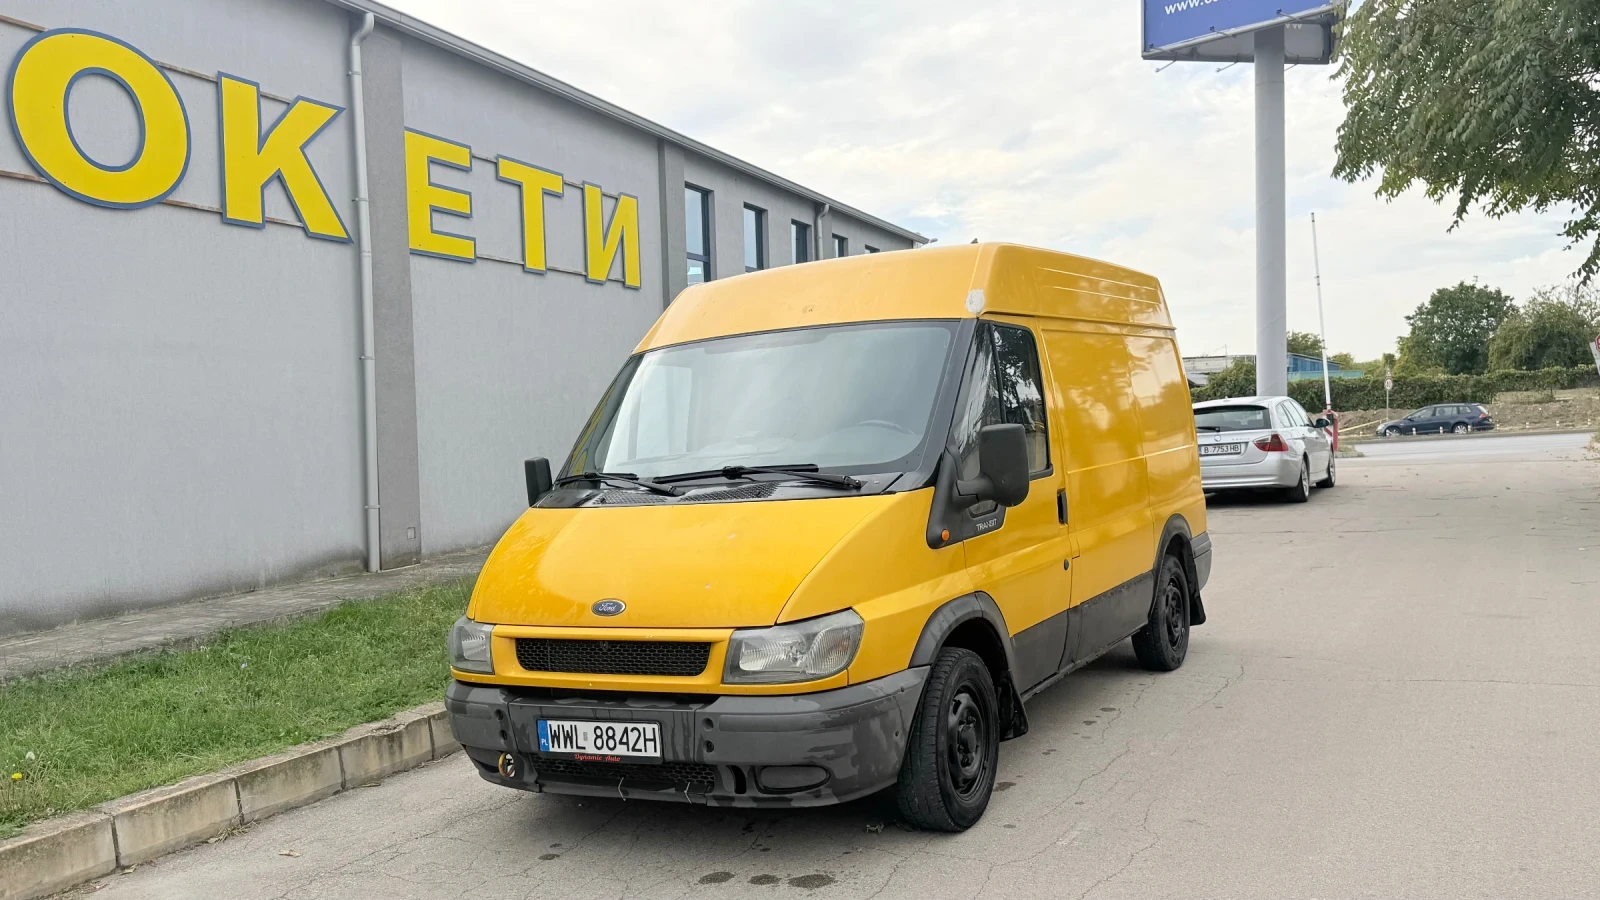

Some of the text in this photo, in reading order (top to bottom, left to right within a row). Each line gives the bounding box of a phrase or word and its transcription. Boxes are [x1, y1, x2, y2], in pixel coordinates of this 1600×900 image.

[1212, 445, 1229, 453] 7753
[976, 518, 997, 531] TRANSIT
[598, 602, 617, 612] Ford
[541, 738, 548, 746] PL
[549, 723, 657, 753] WWL 8842H
[574, 753, 602, 761] Dynamic
